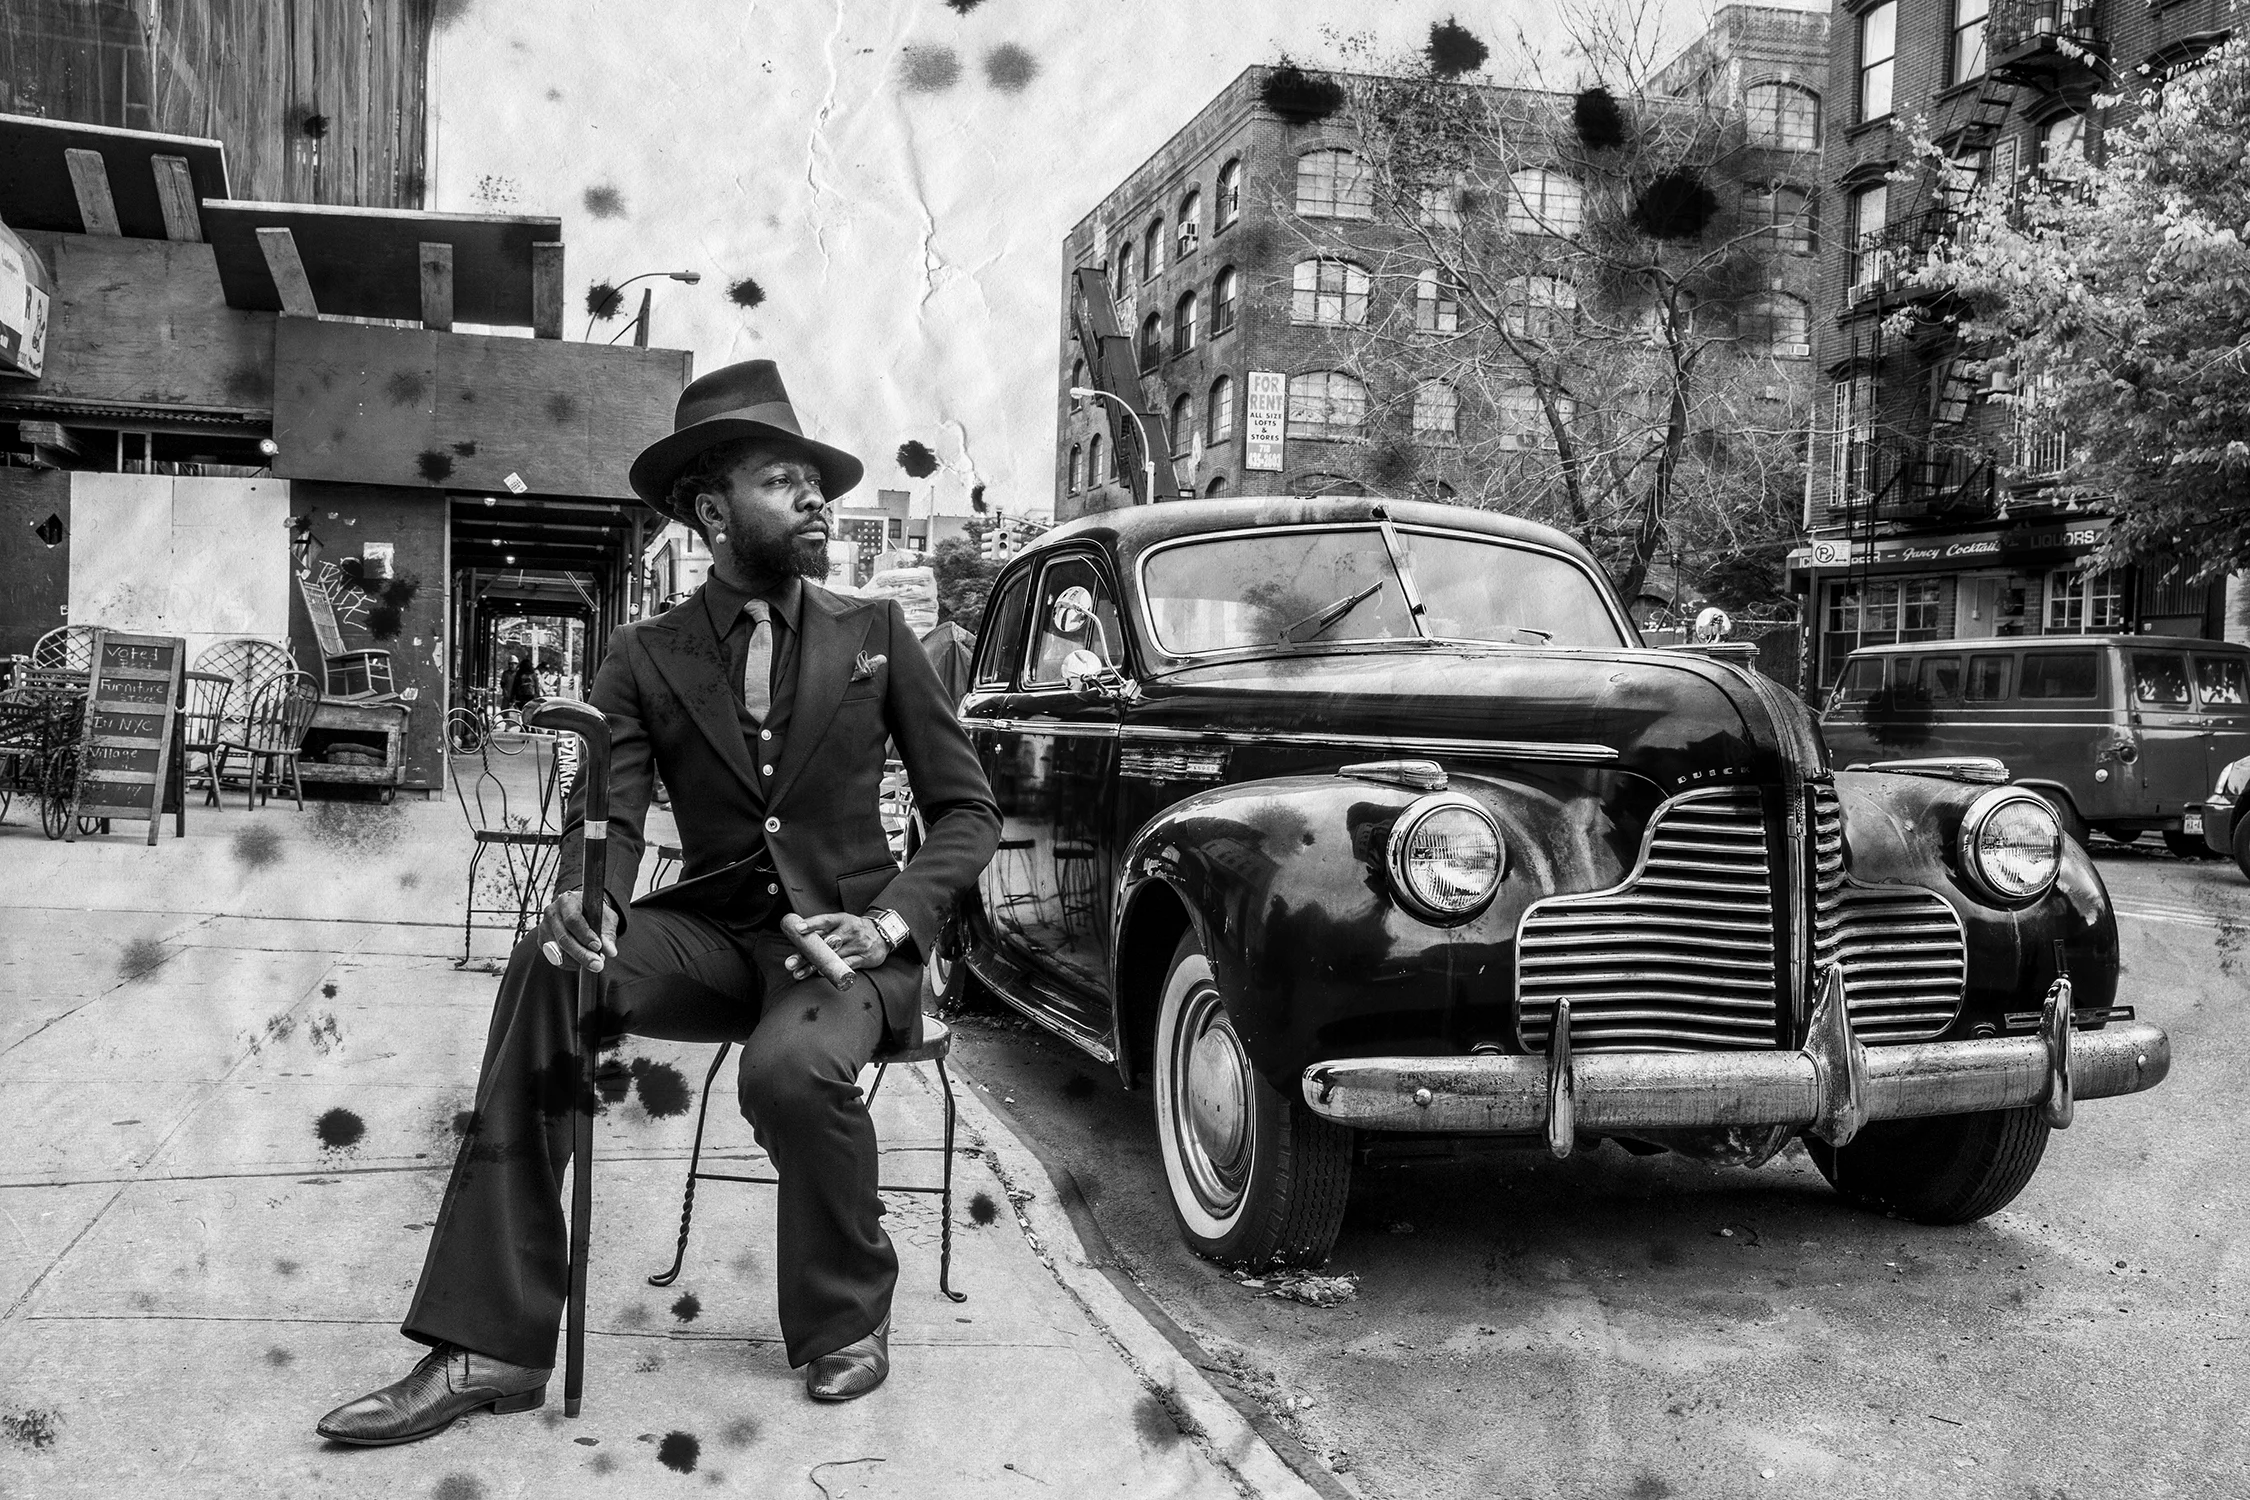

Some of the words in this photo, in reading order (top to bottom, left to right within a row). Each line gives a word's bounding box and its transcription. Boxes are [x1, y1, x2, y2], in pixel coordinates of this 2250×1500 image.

[1254, 376, 1279, 393] FOR
[1249, 394, 1283, 410] RENT
[1254, 419, 1277, 427] LOFTS
[1251, 433, 1280, 441] STORES
[1259, 444, 1271, 453] 718
[1902, 547, 1941, 562] Fancy
[2030, 529, 2095, 549] LIQUORS
[105, 645, 158, 661] Voted
[101, 679, 164, 694] Furniture
[119, 718, 153, 734] NYC
[89, 746, 138, 762] Village
